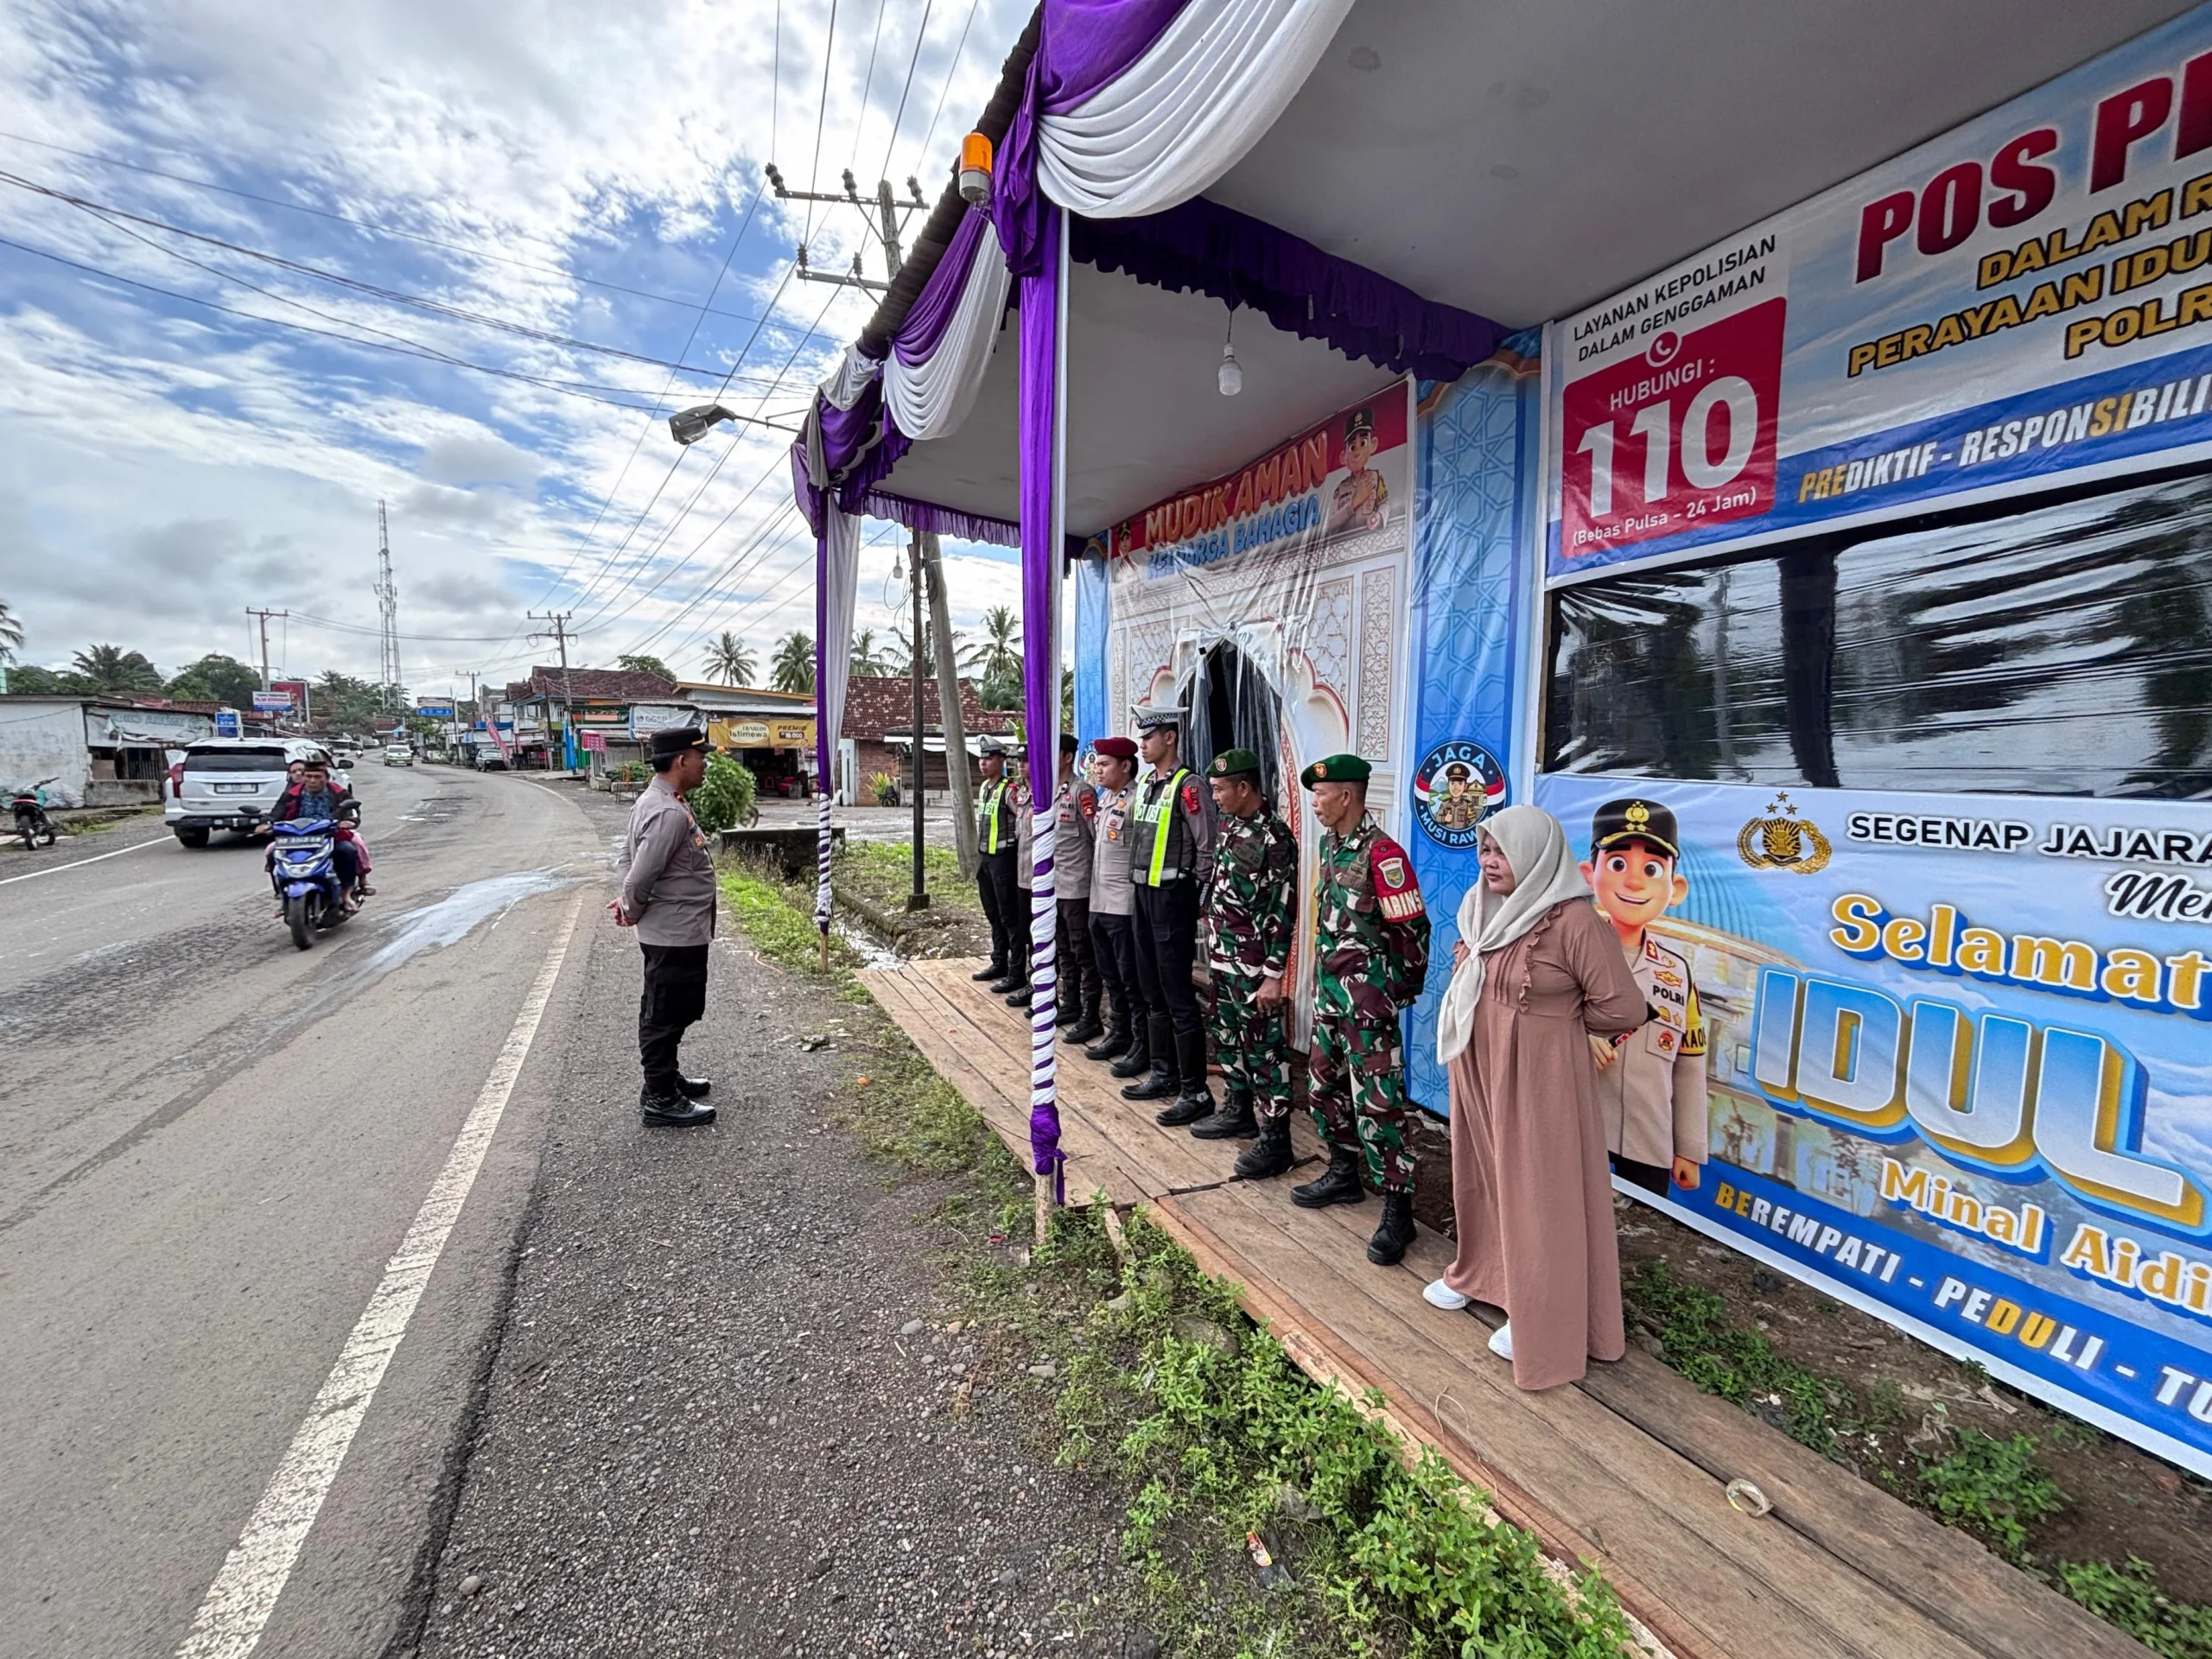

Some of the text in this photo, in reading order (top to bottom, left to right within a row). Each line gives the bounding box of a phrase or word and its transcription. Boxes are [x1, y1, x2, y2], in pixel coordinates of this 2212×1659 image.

[1855, 128, 2057, 283] POS
[1976, 188, 2174, 290] DALAM
[1573, 234, 1776, 341] LAYANAN KEPOLISIAN
[1578, 266, 1765, 362] DALAM GENGGAMAN
[1847, 264, 2105, 378] PERAYAAN
[1610, 359, 1702, 411] HUBUNGI
[1575, 375, 1758, 518] 110
[1797, 441, 1938, 503] PREDIKTIF
[1958, 372, 2212, 467] RESPONSIBILI
[1145, 430, 1328, 551] MUDIK AMAN
[1233, 493, 1321, 554] BAHAGIA
[1573, 523, 1620, 547] (Bebas
[1624, 512, 1668, 533] Pulsa
[1687, 502, 1707, 518] 24
[1712, 486, 1757, 512] Jam)
[1432, 746, 1486, 769] JAGA
[1420, 811, 1478, 844] MUSI RAW
[1850, 815, 2029, 851] SEGENAP
[1378, 887, 1426, 918] ABINS
[1829, 893, 2212, 1010] Selamat
[1652, 985, 1685, 1006] POLRI
[1752, 967, 2190, 1212] IDUL
[1715, 1181, 1901, 1283] BEREMPATI
[1934, 1276, 2104, 1370] PEDULI
[1881, 1157, 2212, 1315] Minal Aidi
